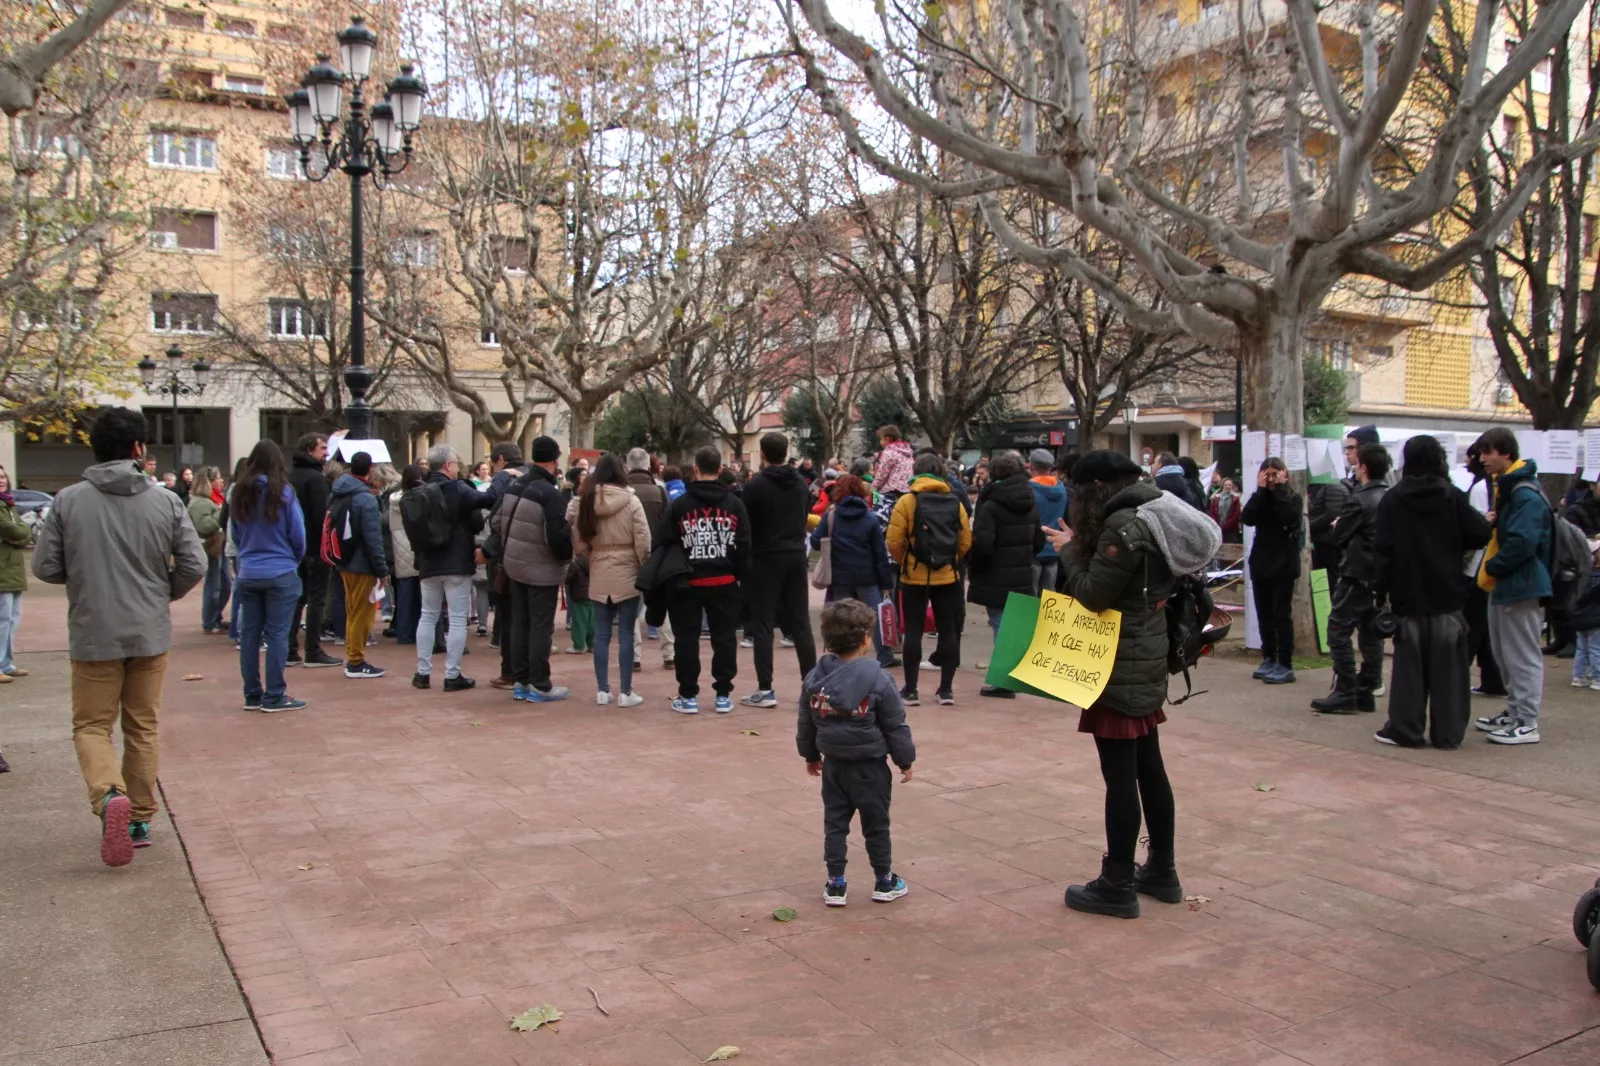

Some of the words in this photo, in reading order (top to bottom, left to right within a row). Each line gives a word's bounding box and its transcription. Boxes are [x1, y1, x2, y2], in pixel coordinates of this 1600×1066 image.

[682, 517, 714, 535] BACK
[715, 517, 732, 531] TO
[719, 531, 736, 546] WE
[1042, 597, 1066, 624] PARA
[1072, 613, 1116, 637] APRENDER
[1061, 633, 1084, 652] COLE
[1087, 642, 1109, 660] HAY
[1031, 651, 1052, 668] QUE
[1052, 660, 1101, 686] DEFENDER
